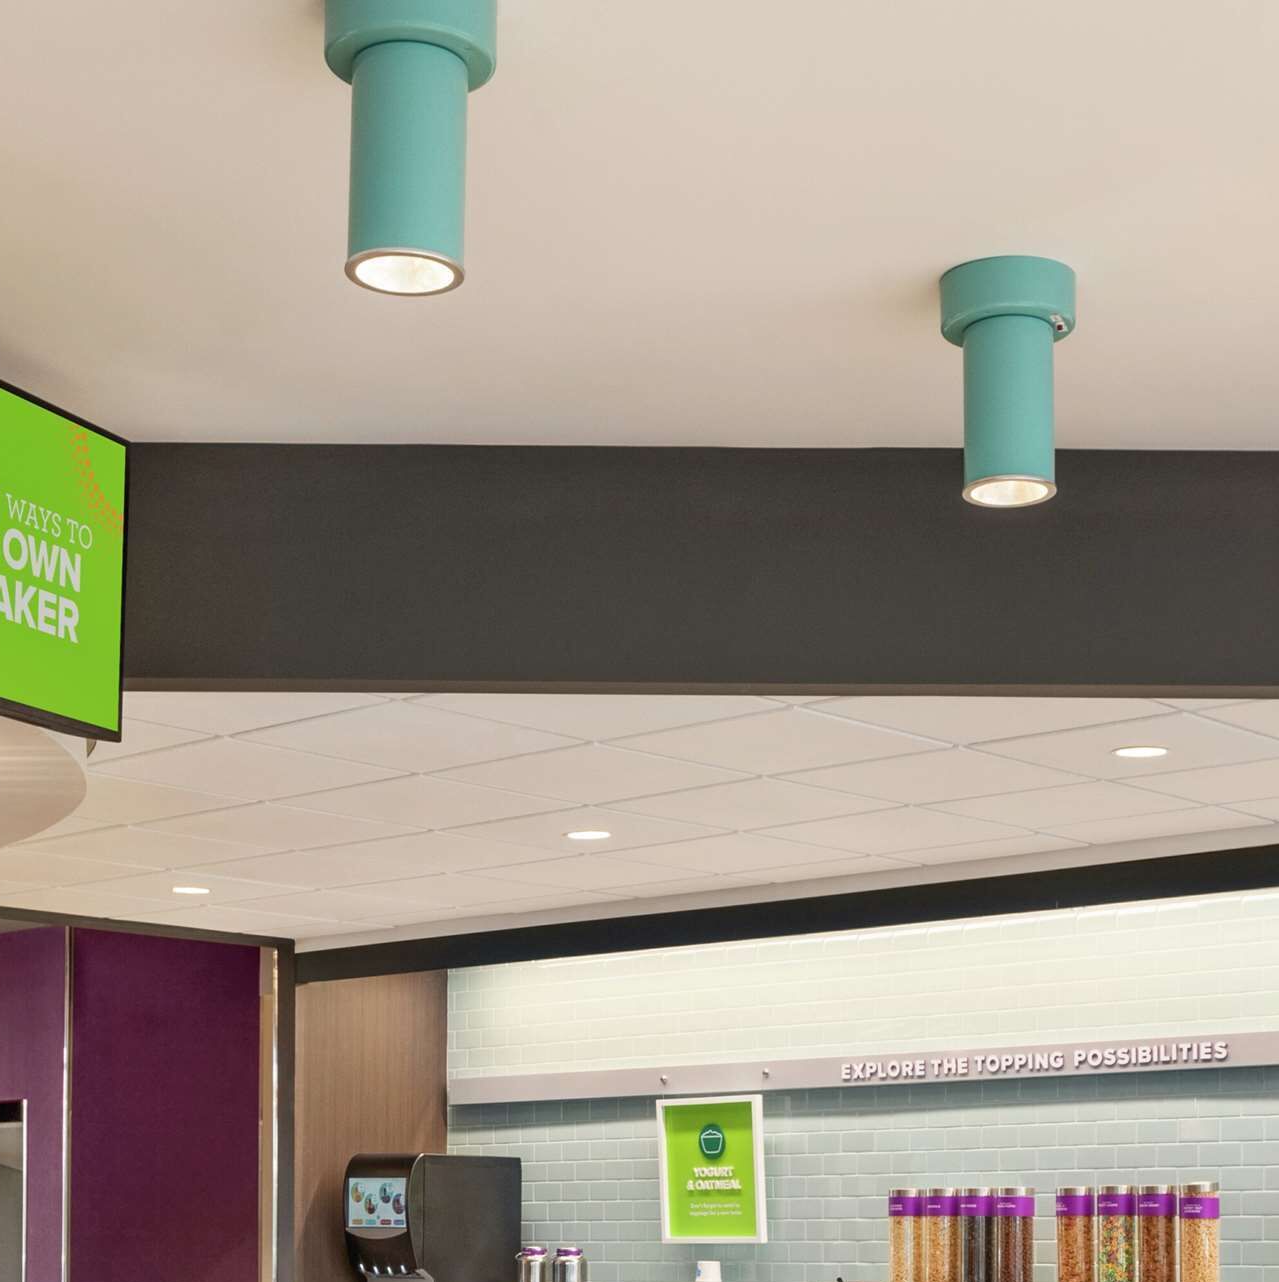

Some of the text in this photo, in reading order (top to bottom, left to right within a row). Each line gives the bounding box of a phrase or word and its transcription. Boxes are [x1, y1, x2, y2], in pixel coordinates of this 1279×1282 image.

[6, 493, 62, 538] WAYS
[66, 518, 93, 550] TO
[2, 527, 82, 593] OWN
[841, 1041, 1229, 1081] EXPLORE THE TOPPING POSSIBILITIES
[686, 1179, 742, 1190] & OATMEAL
[693, 1166, 734, 1177] YOGURT
